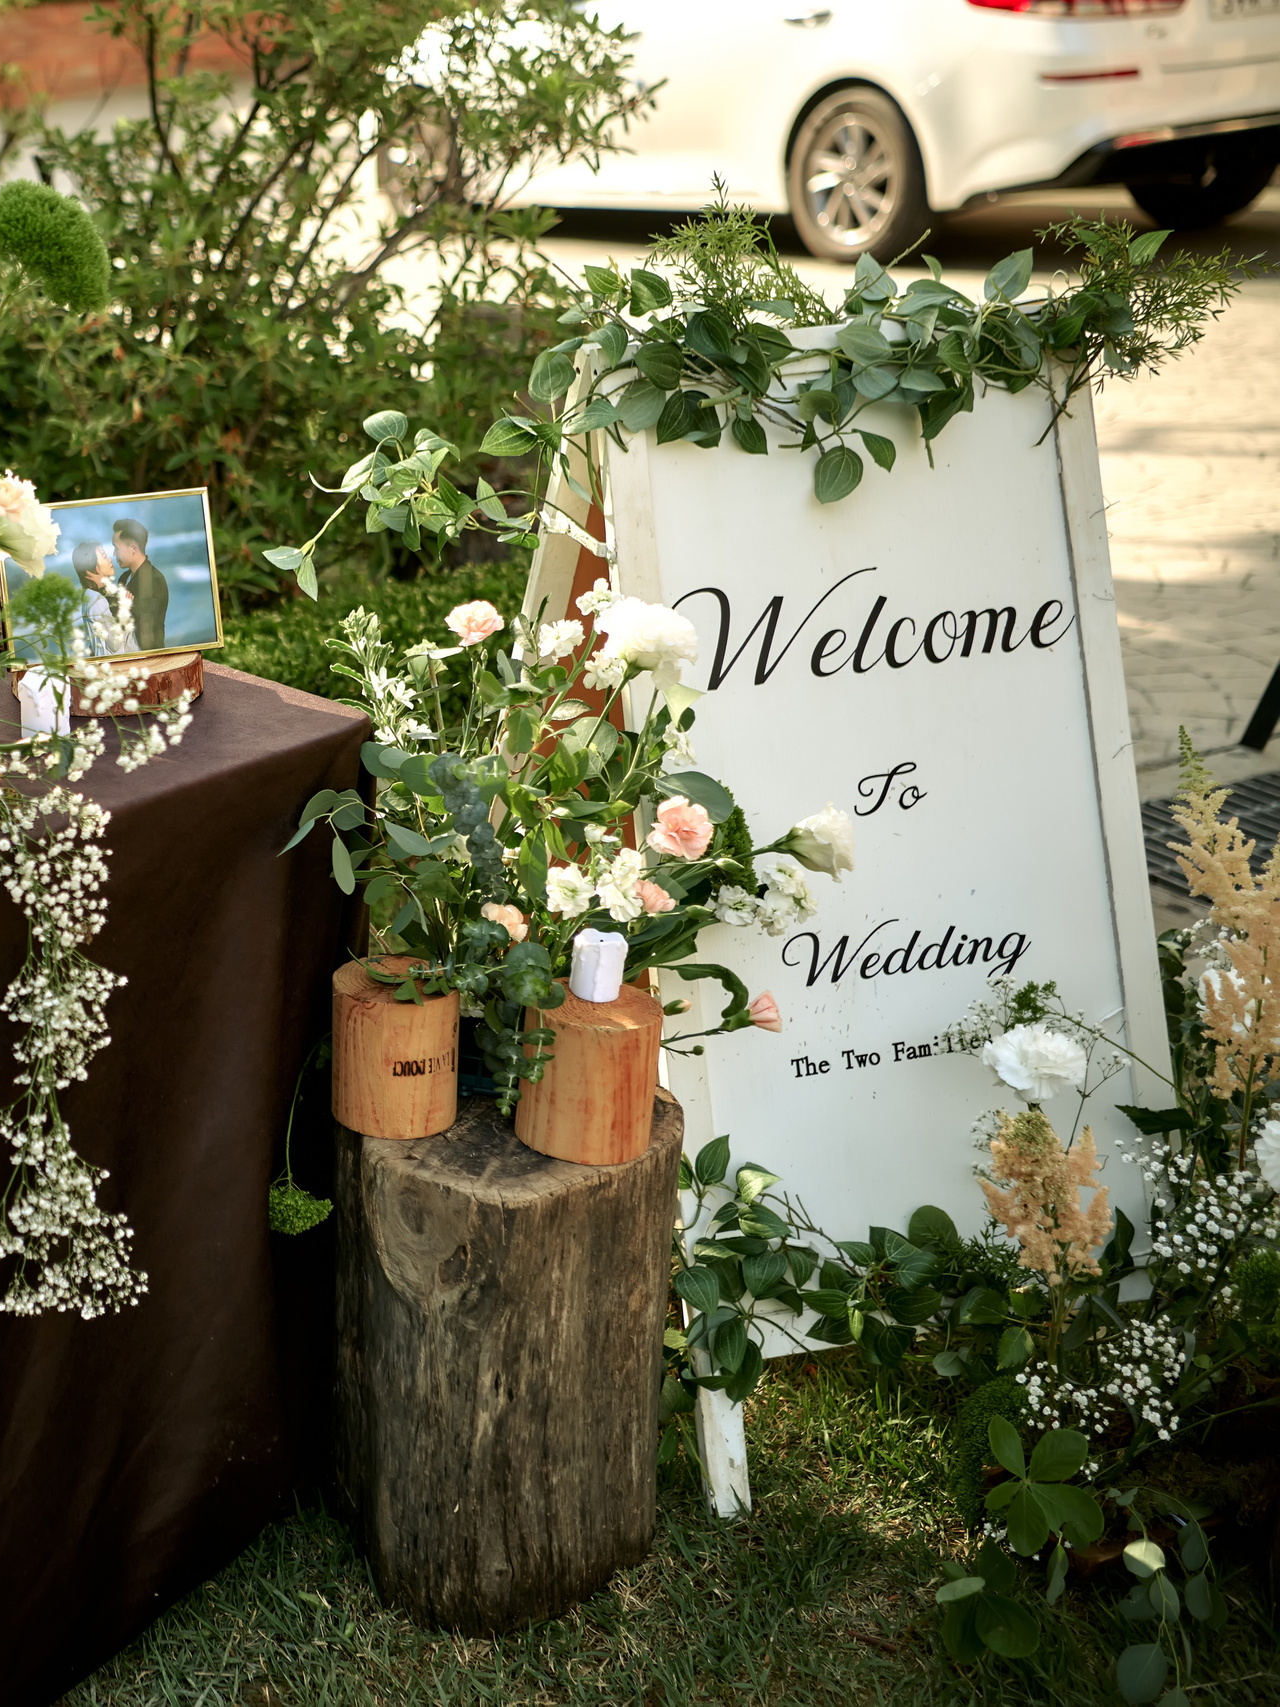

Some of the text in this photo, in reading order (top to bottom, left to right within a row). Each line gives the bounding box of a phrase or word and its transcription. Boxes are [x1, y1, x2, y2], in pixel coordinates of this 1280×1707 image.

[671, 566, 1076, 692] Welcome
[854, 761, 928, 817] To
[781, 918, 1032, 987] Wedding
[791, 1055, 831, 1078] The
[842, 1048, 881, 1070] Two
